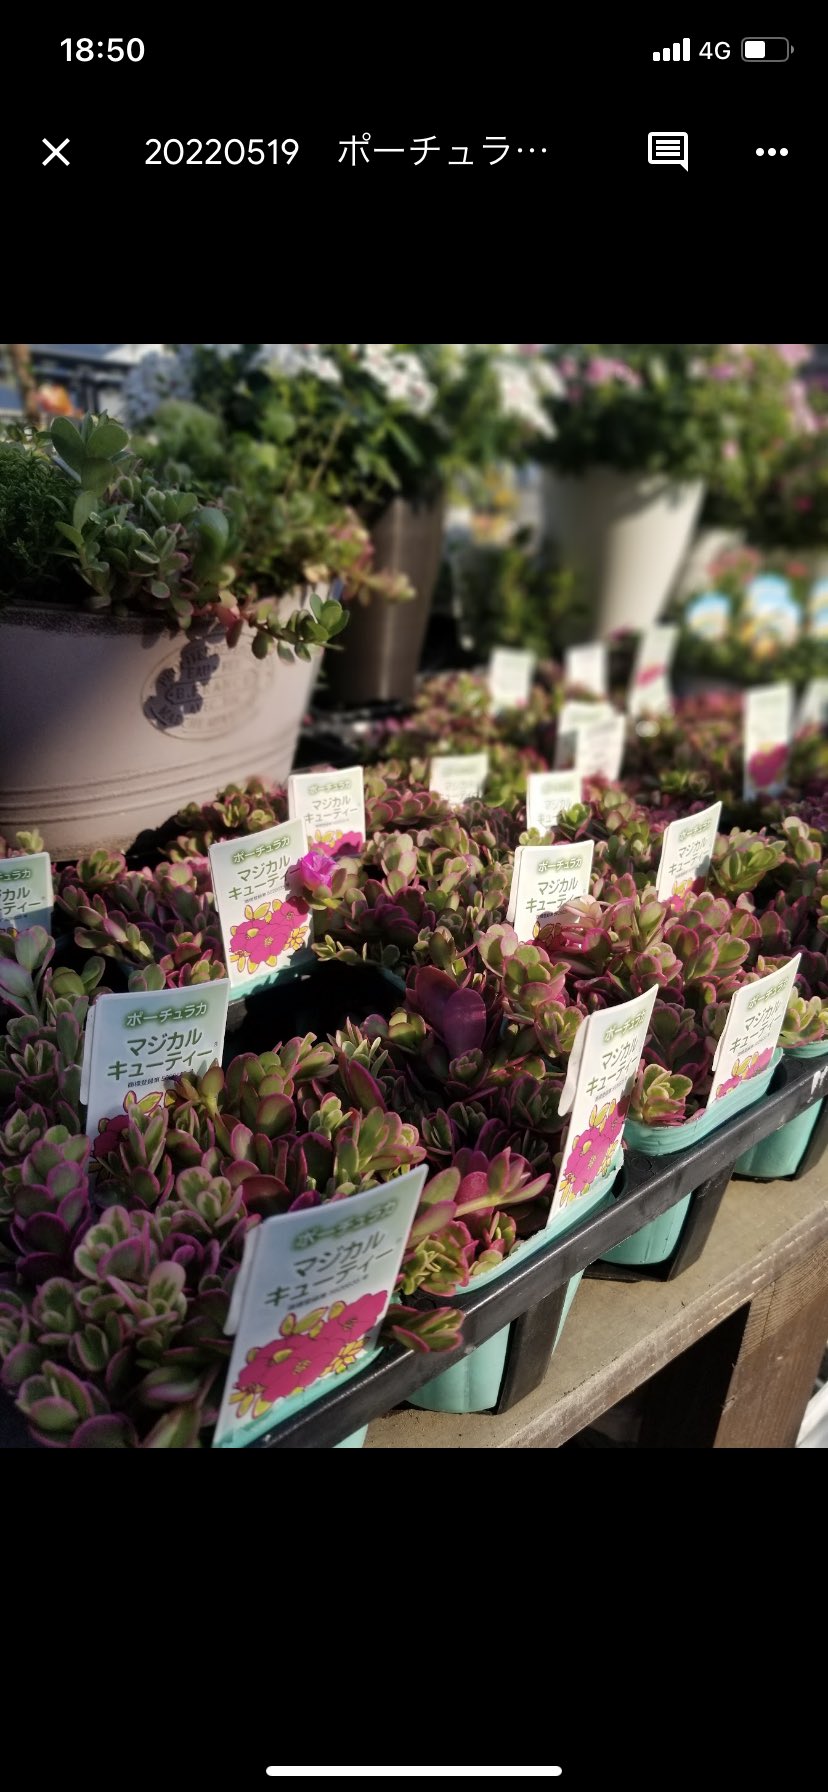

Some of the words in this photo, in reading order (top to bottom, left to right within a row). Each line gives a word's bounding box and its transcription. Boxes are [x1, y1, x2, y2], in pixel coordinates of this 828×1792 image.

[304, 807, 358, 823] キューティー
[312, 796, 351, 810] マジカル
[233, 836, 290, 863] ポーチュラカ
[237, 855, 291, 881] マジカル
[538, 857, 583, 873] ポーチュラカ
[0, 886, 31, 902] カル
[537, 877, 579, 896] マジカル
[0, 901, 41, 915] ティー
[127, 1002, 207, 1027] ポーチュラカ
[127, 1028, 203, 1057] マジカル
[602, 1037, 638, 1070] マジカル
[107, 1050, 213, 1081] キューティー
[586, 1056, 638, 1097] キューティー
[293, 1231, 386, 1278] マジカル
[264, 1248, 393, 1307] キューティー
